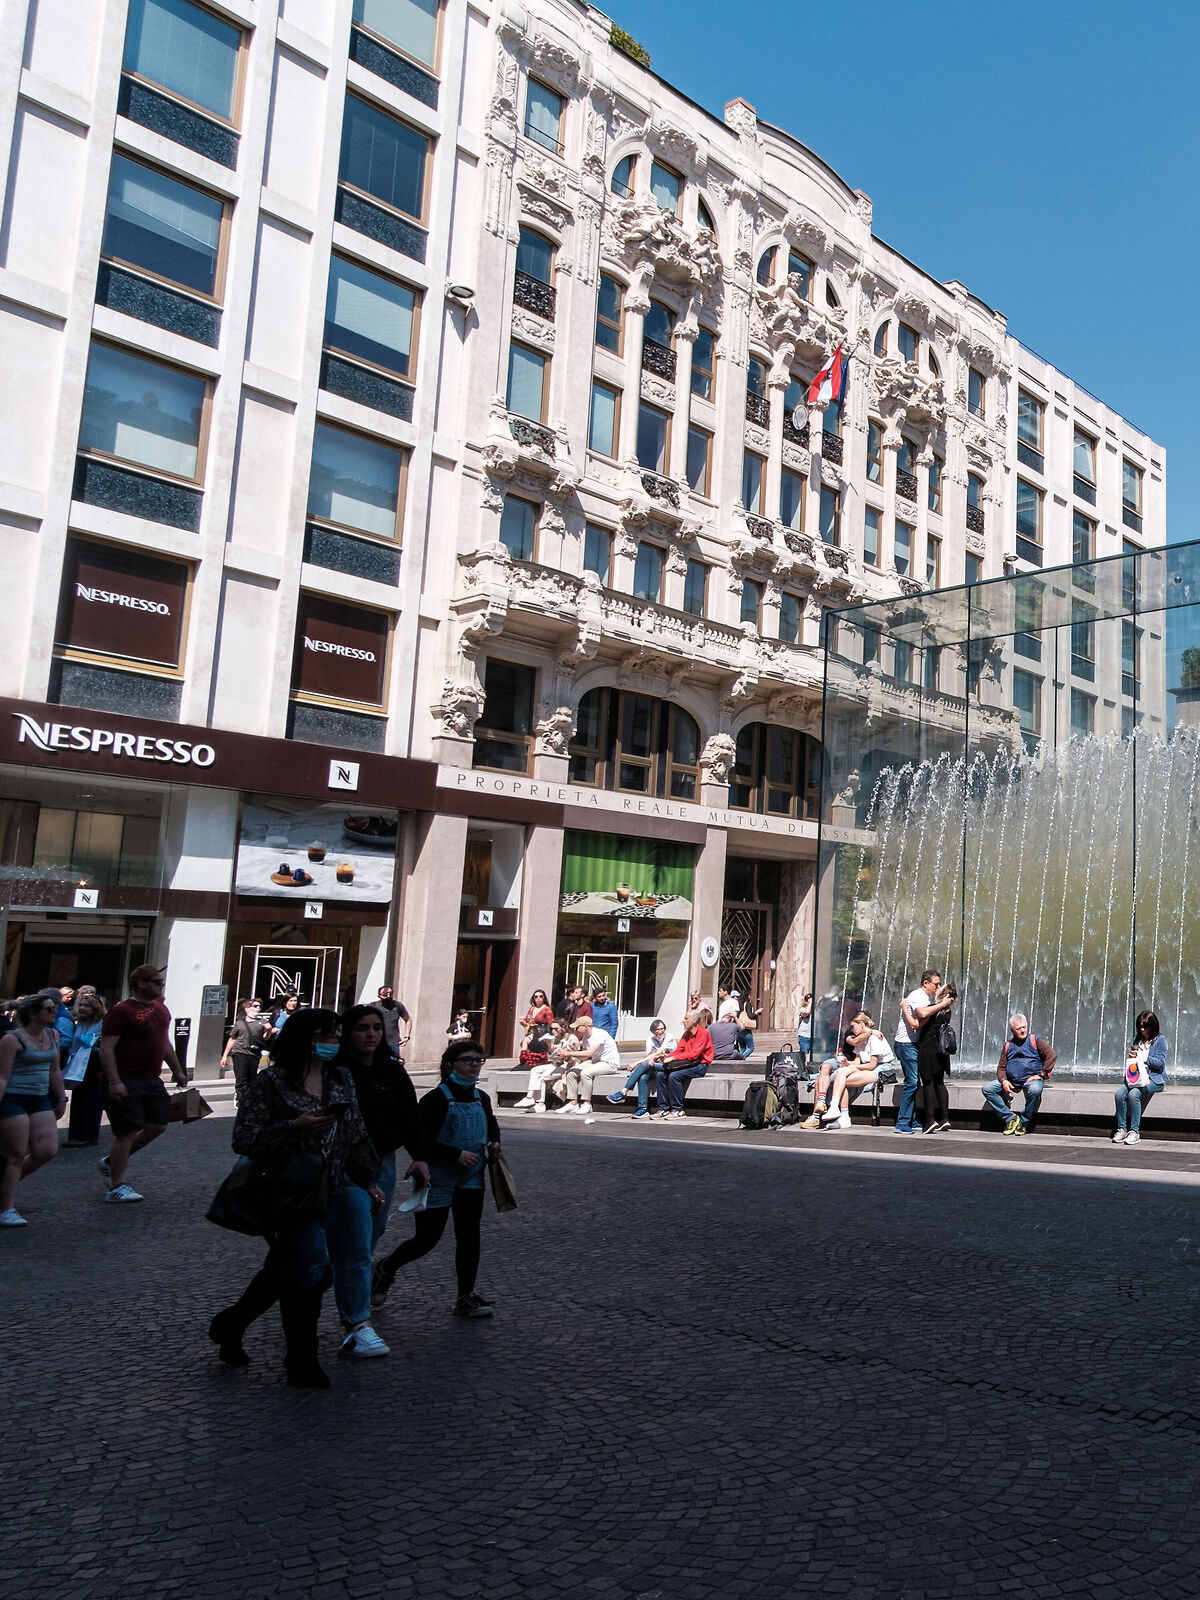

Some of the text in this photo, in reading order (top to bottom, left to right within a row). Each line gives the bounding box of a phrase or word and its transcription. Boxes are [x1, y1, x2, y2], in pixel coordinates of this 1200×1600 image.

[11, 712, 216, 767] NESPRESSO
[336, 765, 353, 785] N
[456, 773, 599, 805] PROPRIETA
[622, 798, 688, 818] REALE
[707, 811, 771, 830] MUTUA
[787, 822, 806, 834] DI
